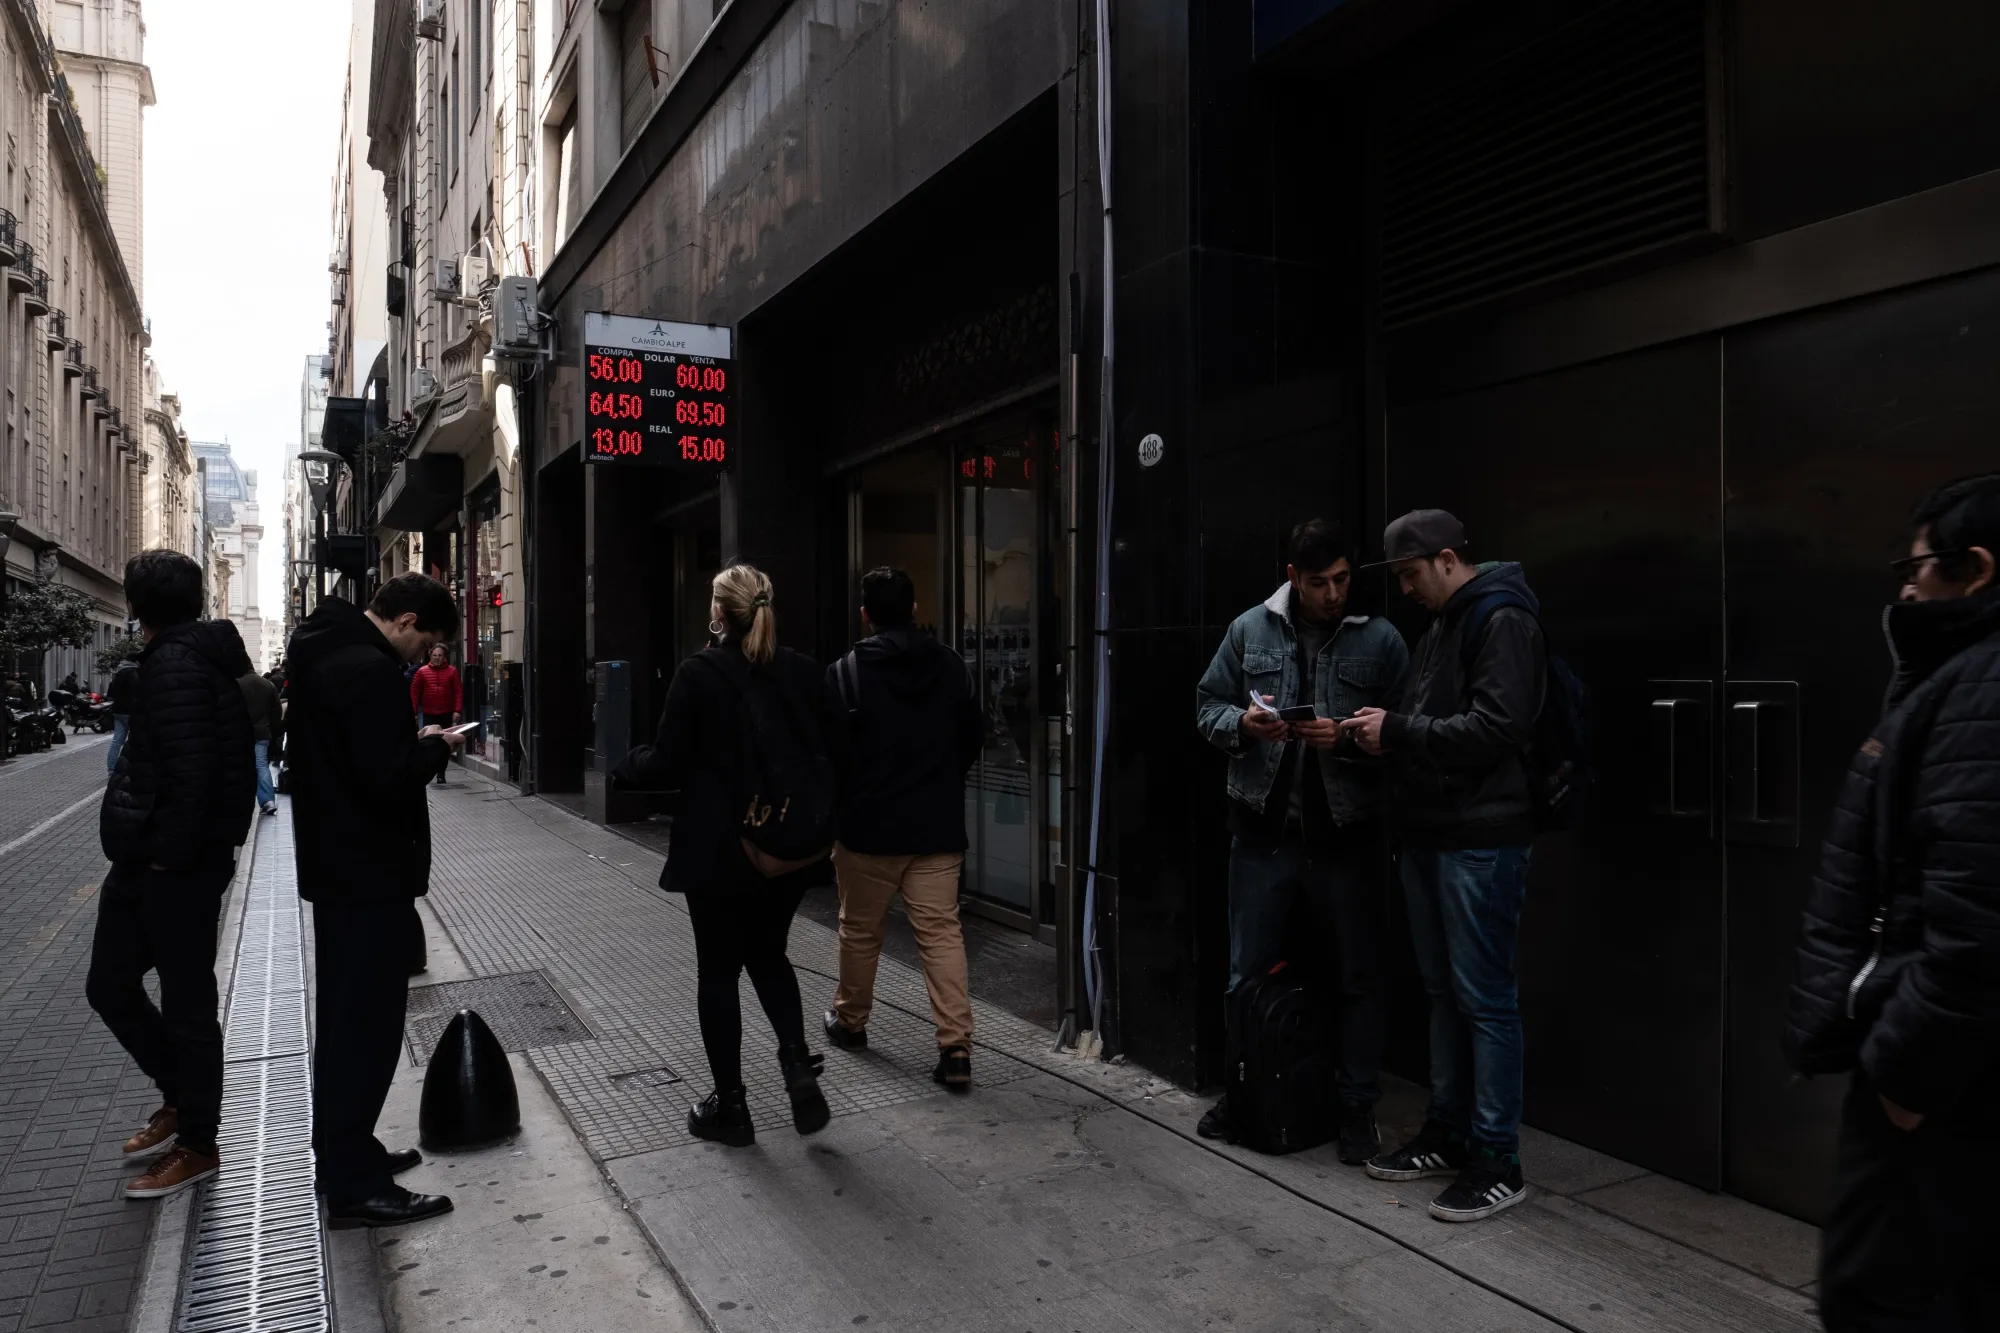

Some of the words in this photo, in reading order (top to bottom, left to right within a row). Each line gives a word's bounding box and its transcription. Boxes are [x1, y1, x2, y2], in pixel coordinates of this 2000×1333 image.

[632, 337, 686, 348] CAMBIOALPE
[598, 347, 634, 357] COMPRA
[644, 353, 676, 363] DOLAR
[690, 356, 715, 365] VENTA
[590, 355, 642, 383] 56,00
[676, 364, 725, 392] 60,00
[650, 389, 675, 398] EURO
[590, 392, 642, 419] 64,50
[650, 425, 672, 434] REAL
[592, 428, 642, 455] 13,00
[678, 436, 725, 461] 15,00
[1141, 440, 1158, 460] 488
